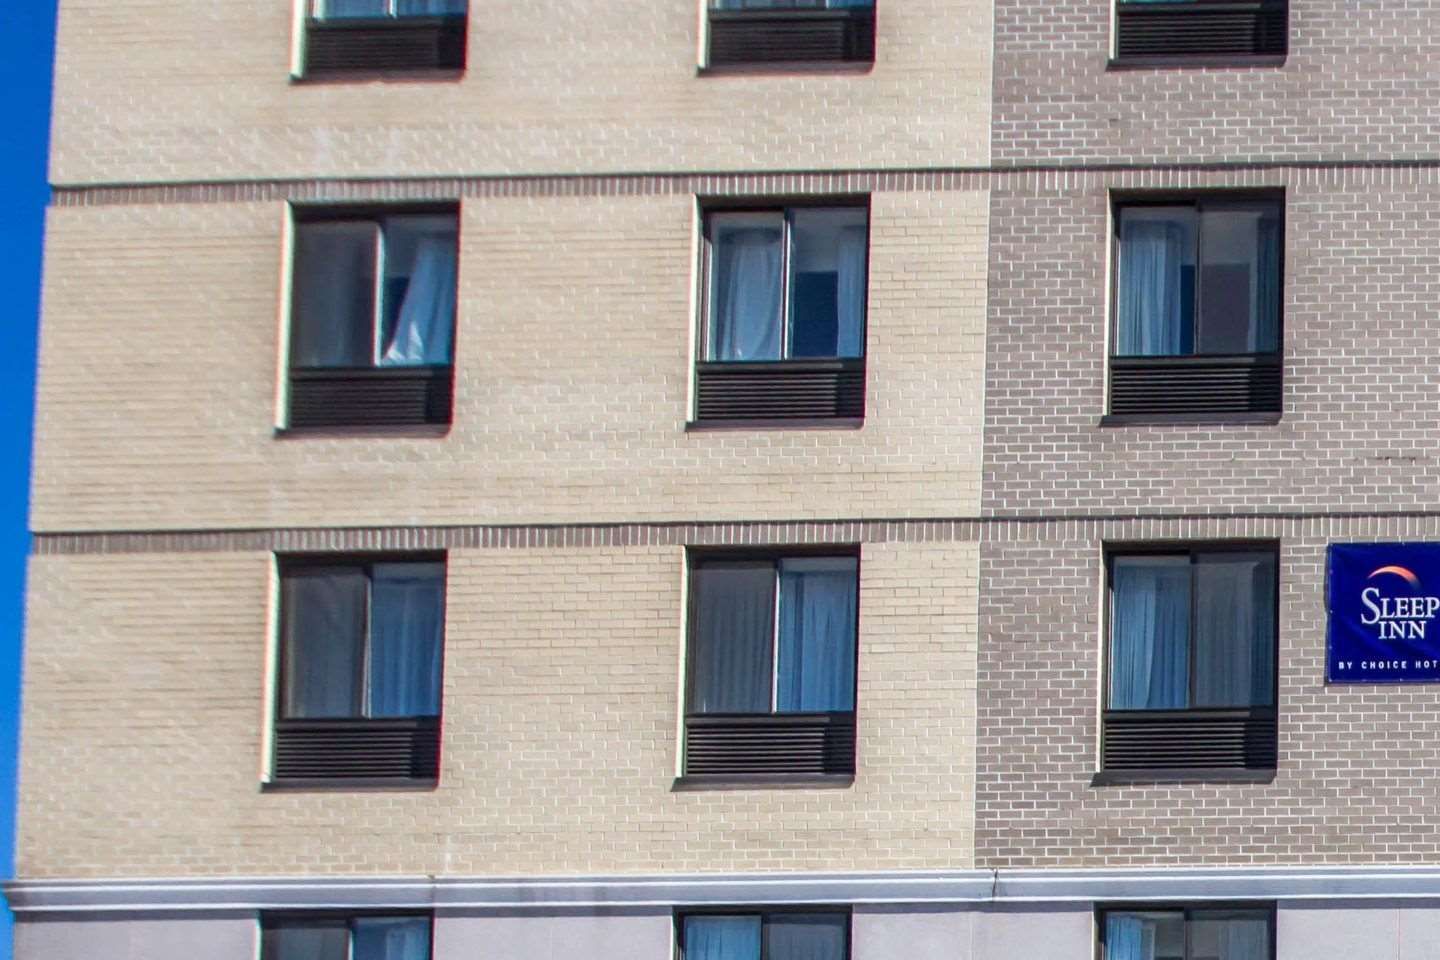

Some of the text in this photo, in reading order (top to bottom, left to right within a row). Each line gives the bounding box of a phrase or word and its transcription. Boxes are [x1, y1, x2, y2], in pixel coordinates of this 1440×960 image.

[1361, 587, 1440, 624] SLEEP
[1378, 620, 1427, 640] INN
[1338, 661, 1353, 670] BY
[1361, 660, 1408, 670] CHOICE
